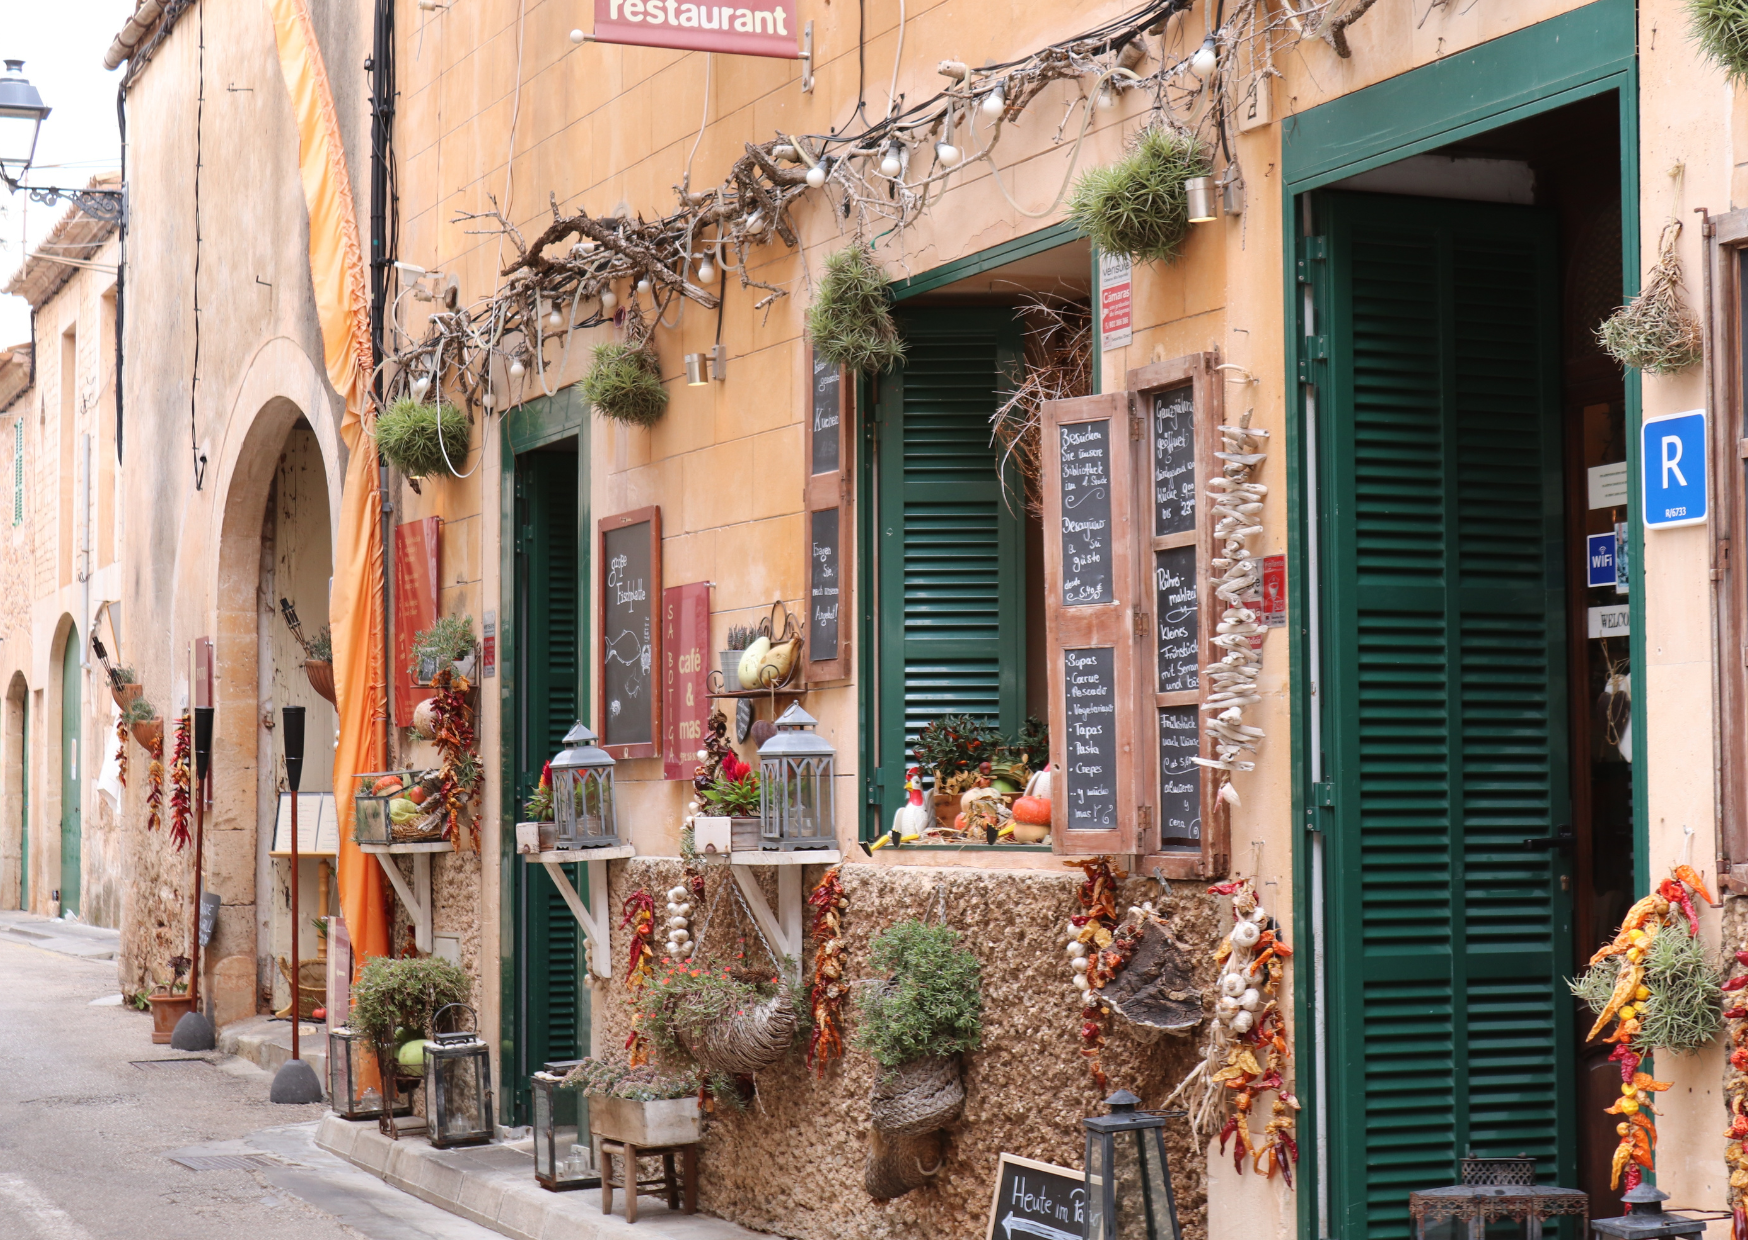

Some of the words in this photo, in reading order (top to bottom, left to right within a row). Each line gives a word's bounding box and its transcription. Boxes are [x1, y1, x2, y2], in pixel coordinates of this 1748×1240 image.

[609, 0, 788, 36] restaurant
[1103, 289, 1130, 303] Cámaras
[1061, 447, 1076, 462] Sie
[1661, 434, 1688, 489] R
[1665, 506, 1687, 518] R/6733
[678, 647, 701, 674] café
[1161, 664, 1176, 680] mit
[1166, 678, 1183, 690] und
[686, 682, 694, 707] &
[679, 719, 701, 739] mas
[1073, 722, 1103, 739] Tapas
[1074, 740, 1100, 755] Pasta
[1075, 762, 1103, 777] Crepes
[1012, 1176, 1053, 1214] Heute
[1055, 1194, 1069, 1223] im
